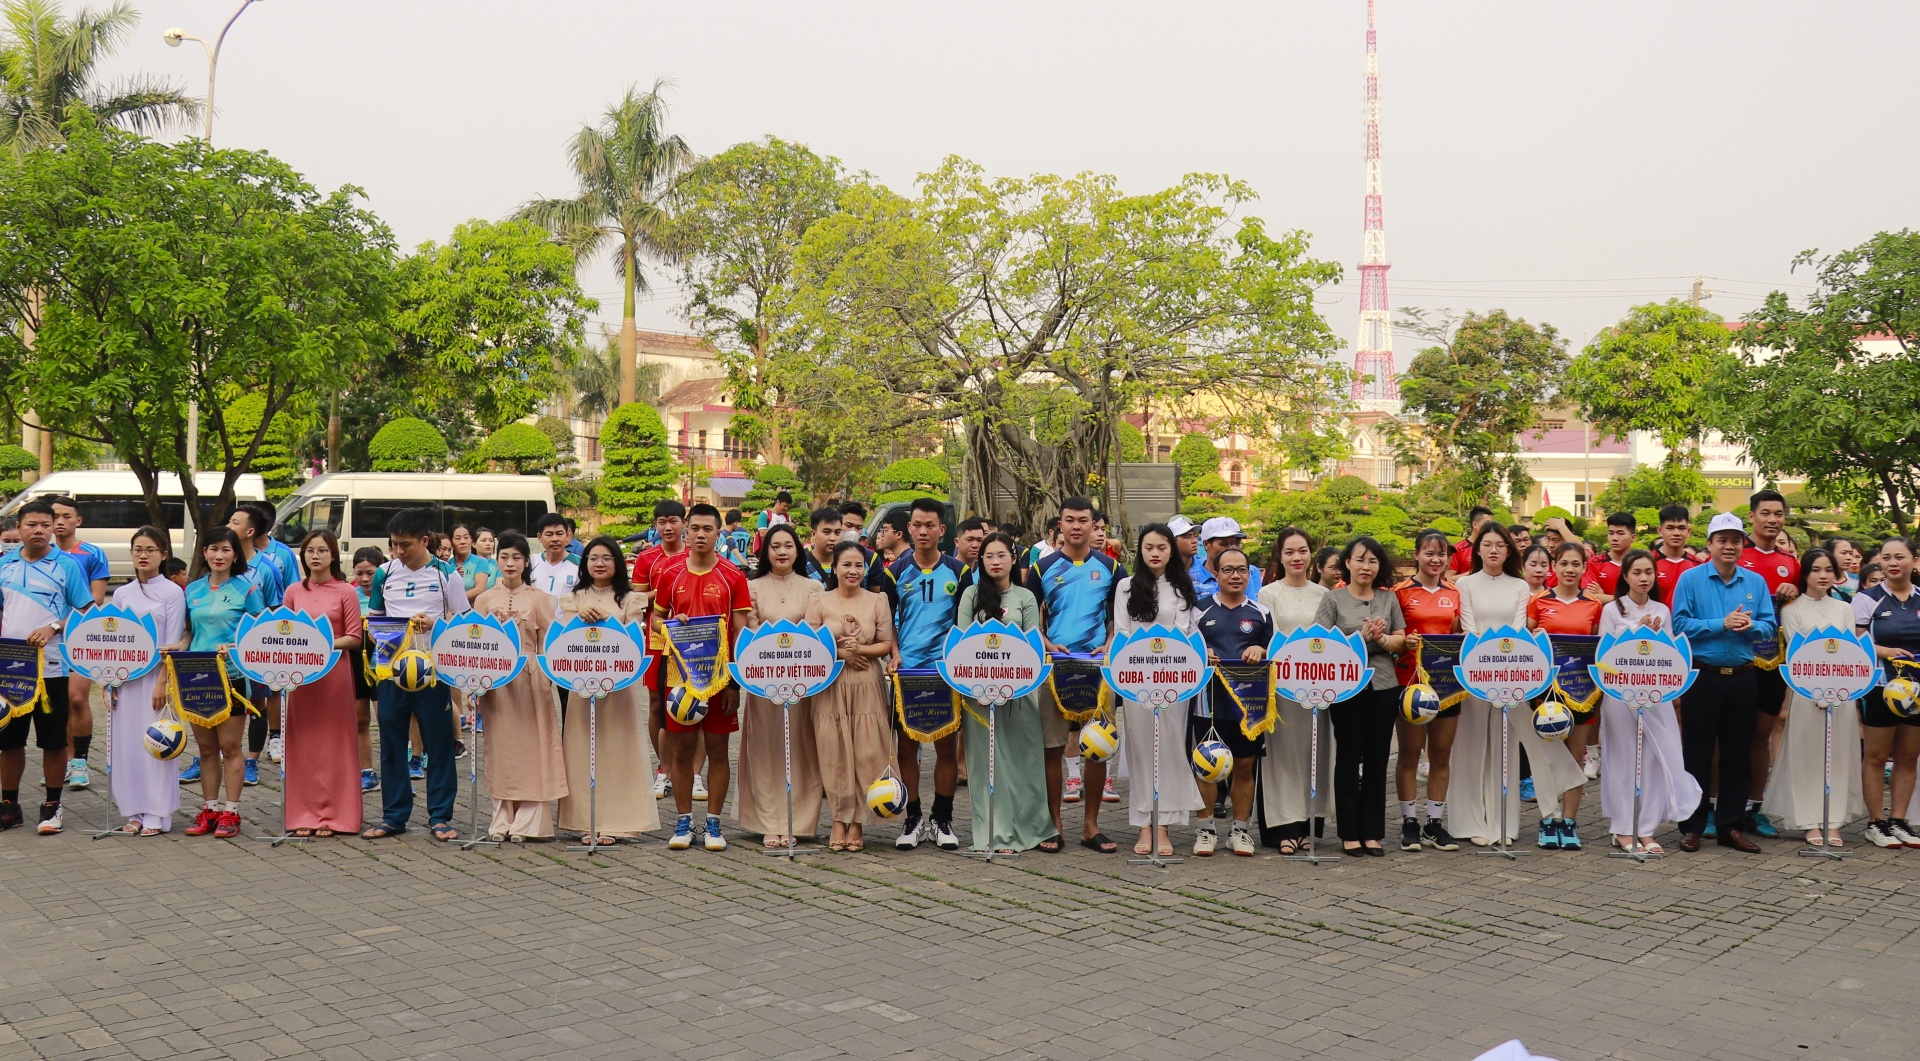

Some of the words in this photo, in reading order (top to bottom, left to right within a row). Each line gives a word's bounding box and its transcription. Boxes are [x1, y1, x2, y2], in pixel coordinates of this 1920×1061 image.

[736, 538, 745, 553] 10
[406, 582, 415, 597] 2
[549, 575, 555, 591] 7
[919, 579, 934, 602] 11
[87, 633, 101, 641] CÔNG
[103, 634, 117, 642] ĐOÀN
[128, 633, 134, 643] SỞ
[262, 636, 283, 645] CÔNG
[286, 637, 308, 646] ĐOÀN
[452, 639, 465, 648] CÔNG
[467, 641, 481, 649] ĐOÀN
[483, 642, 489, 650] CƠ
[491, 641, 498, 651] SỞ
[73, 648, 84, 659] CTY
[86, 649, 102, 660] TNHH
[104, 649, 117, 661] MTV
[119, 650, 135, 661] LONG
[137, 651, 148, 664] ĐẠI
[568, 644, 583, 652] CÔNG
[602, 645, 610, 653] CƠ
[612, 643, 619, 653] SỞ
[759, 650, 775, 659] CÔNG
[804, 648, 811, 658] SỞ
[976, 651, 998, 659] CÔNG
[245, 649, 270, 663] NGÀNH
[273, 650, 292, 664] CÔNG
[295, 652, 323, 665] THƯƠNG
[438, 652, 457, 666] TRƯỜNG
[459, 655, 467, 670] ĐẠI
[468, 656, 479, 670] HỌC
[480, 654, 497, 670] QUẢNG
[499, 656, 511, 671] BÌNH
[553, 657, 571, 671] VƯỜN
[574, 656, 593, 672] QUỐC
[595, 660, 607, 672] GIA
[614, 660, 634, 672] PNKB
[1129, 656, 1144, 665] BỆNH
[1146, 655, 1158, 665] VIỆN
[1160, 655, 1172, 665] VIỆT
[1479, 654, 1490, 662] LIÊN
[1519, 654, 1533, 664] ĐỘNG
[1616, 657, 1627, 665] LIÊN
[1629, 658, 1644, 666] ĐOÀN
[1657, 658, 1672, 668] ĐỘNG
[746, 664, 764, 678] CÔNG
[766, 666, 774, 678] TY
[776, 666, 785, 678] CP
[787, 663, 801, 680] VIỆT
[804, 665, 825, 677] TRUNG
[954, 664, 972, 678] XĂNG
[975, 662, 988, 678] DẦU
[991, 663, 1014, 680] QUẢNG
[1016, 665, 1032, 679] BÌNH
[1119, 671, 1143, 683] CUBA
[1153, 667, 1178, 683] ĐỒNG
[1276, 655, 1291, 679] TỔ
[1295, 663, 1335, 684] TRỌNG
[1340, 660, 1358, 681] TÀI
[1470, 668, 1492, 682] THÀNH
[1495, 666, 1508, 681] PHỐ
[1793, 661, 1801, 678] BỘ
[1803, 661, 1813, 678] ĐỘI
[1816, 662, 1830, 676] BIÊN
[1832, 662, 1853, 676] PHÒNG
[1604, 671, 1628, 687] HUYỆN
[1631, 670, 1656, 686] QUẢNG
[1659, 674, 1682, 688] TRẠCH
